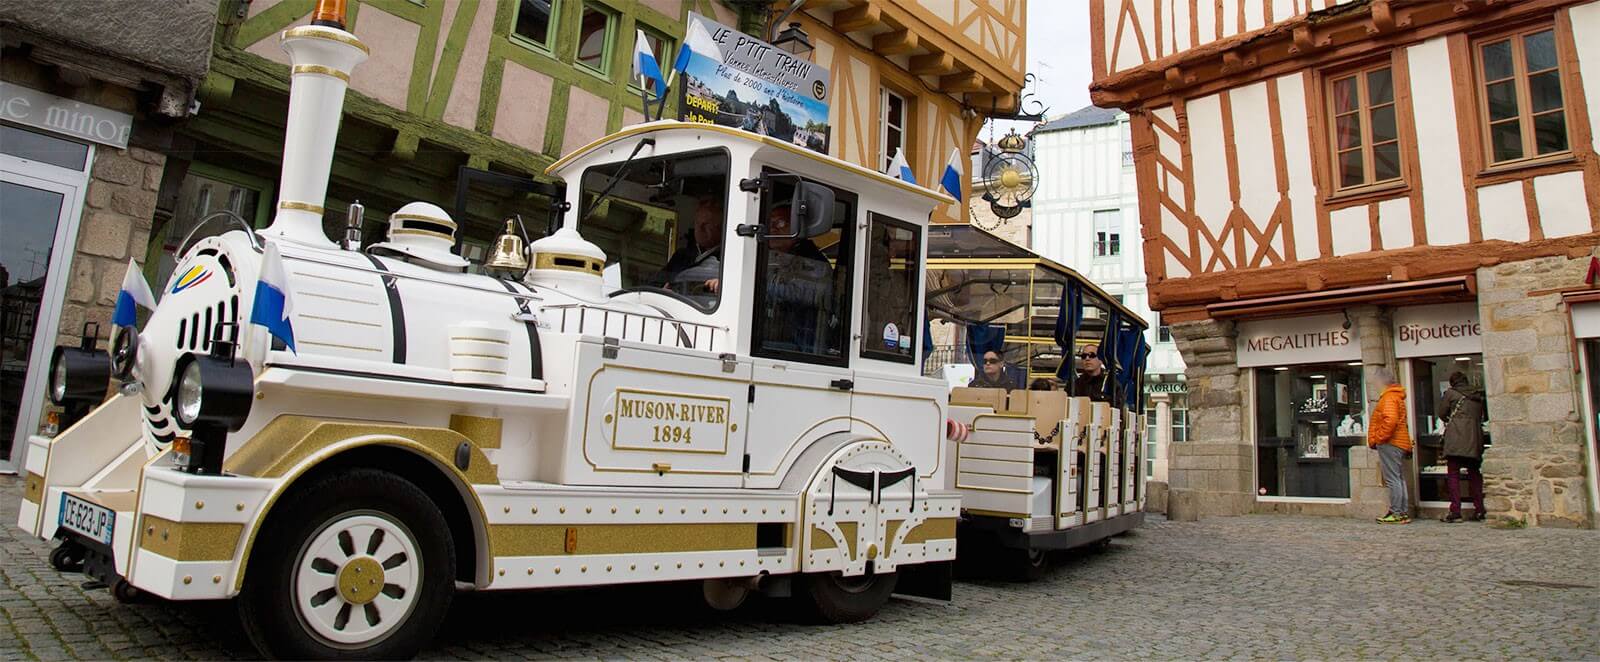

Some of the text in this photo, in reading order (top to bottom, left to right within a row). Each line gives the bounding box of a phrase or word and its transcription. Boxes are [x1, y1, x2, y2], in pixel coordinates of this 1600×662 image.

[712, 27, 811, 80] LE P'TIT TRAIN
[716, 65, 732, 80] Plus
[743, 77, 763, 92] 2000
[44, 103, 130, 144] minor
[1247, 330, 1350, 352] MEGALITHES
[1399, 319, 1482, 346] Bijouterie
[652, 424, 693, 444] 1894
